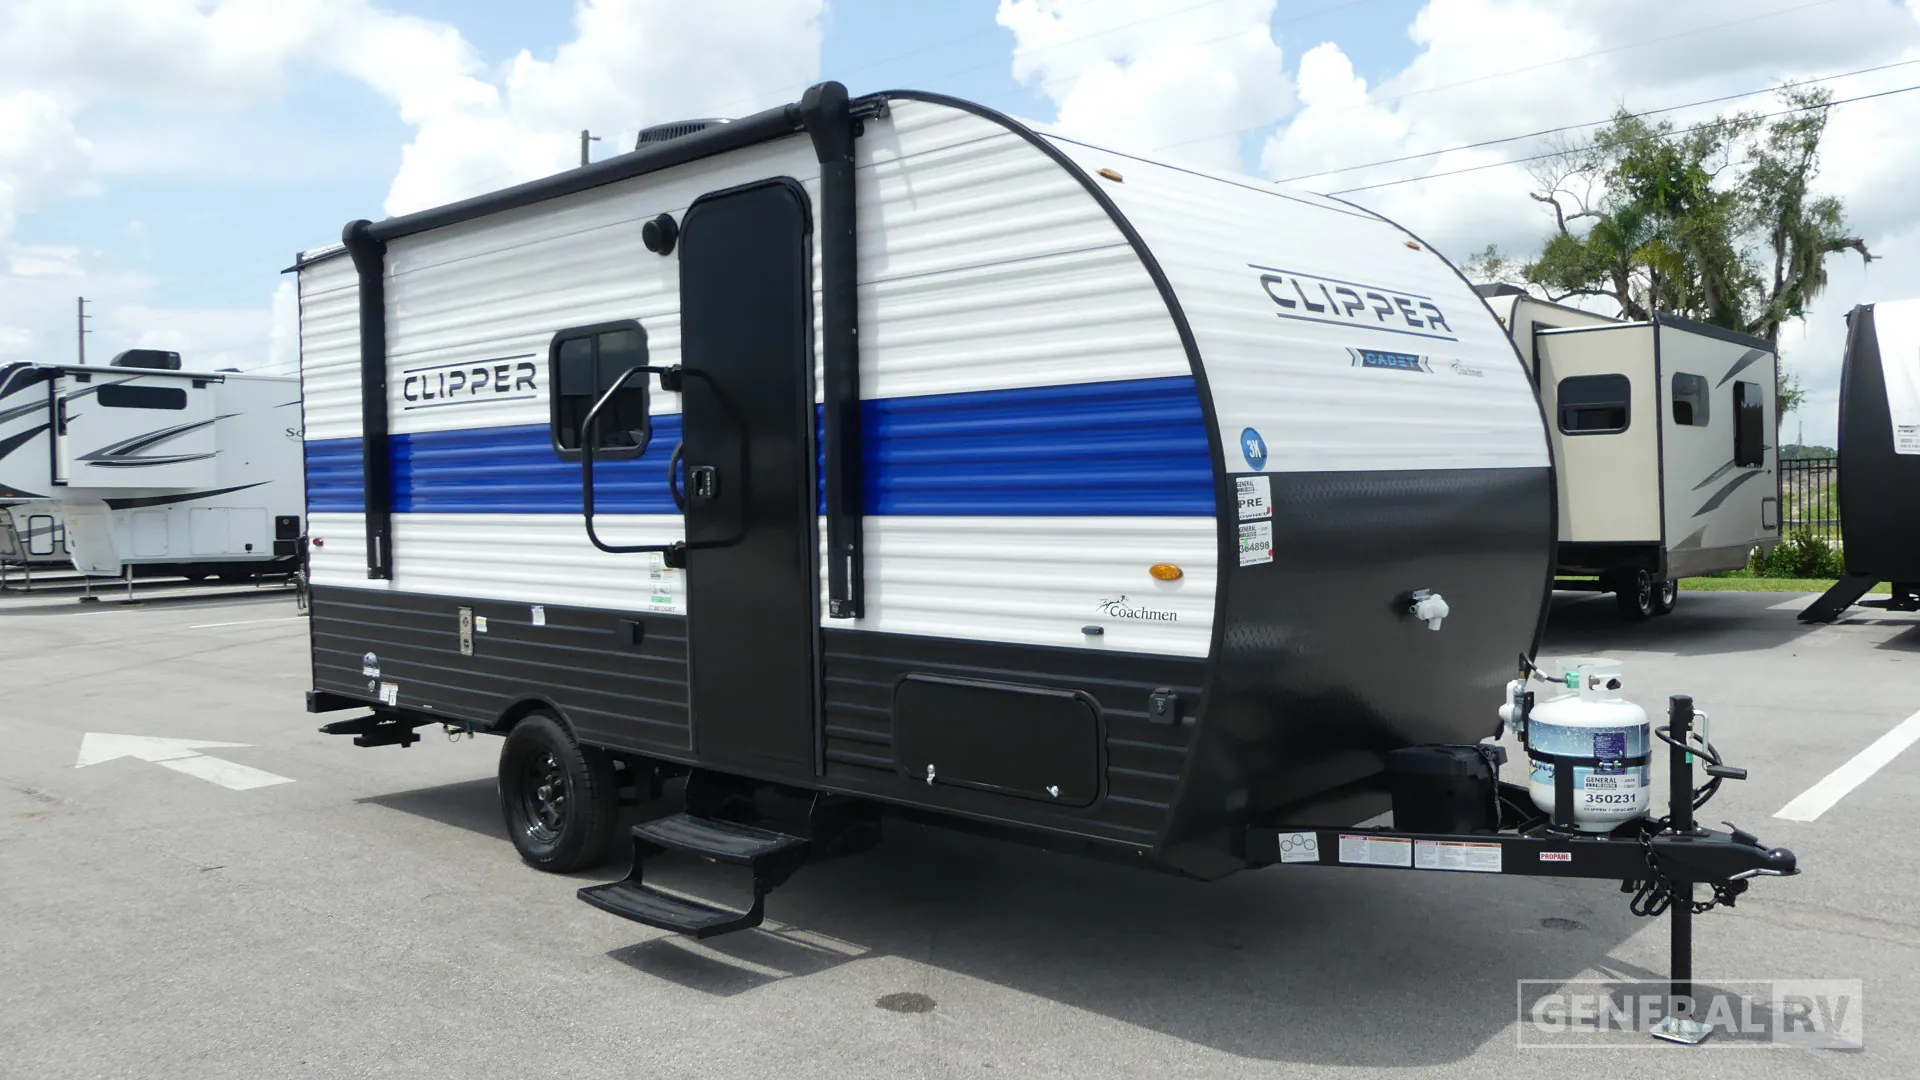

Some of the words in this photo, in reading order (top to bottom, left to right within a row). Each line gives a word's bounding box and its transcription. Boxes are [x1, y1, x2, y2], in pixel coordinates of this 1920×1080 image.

[1260, 273, 1453, 333] CLIPPER
[1365, 352, 1416, 368] CADET
[403, 362, 537, 401] CLIPPER
[1246, 439, 1262, 458] 3K
[1238, 497, 1263, 508] PRE
[1239, 541, 1270, 554] 364898
[1110, 605, 1178, 621] Coachmen
[1585, 776, 1617, 784] GENERAL
[1585, 793, 1636, 804] 350231
